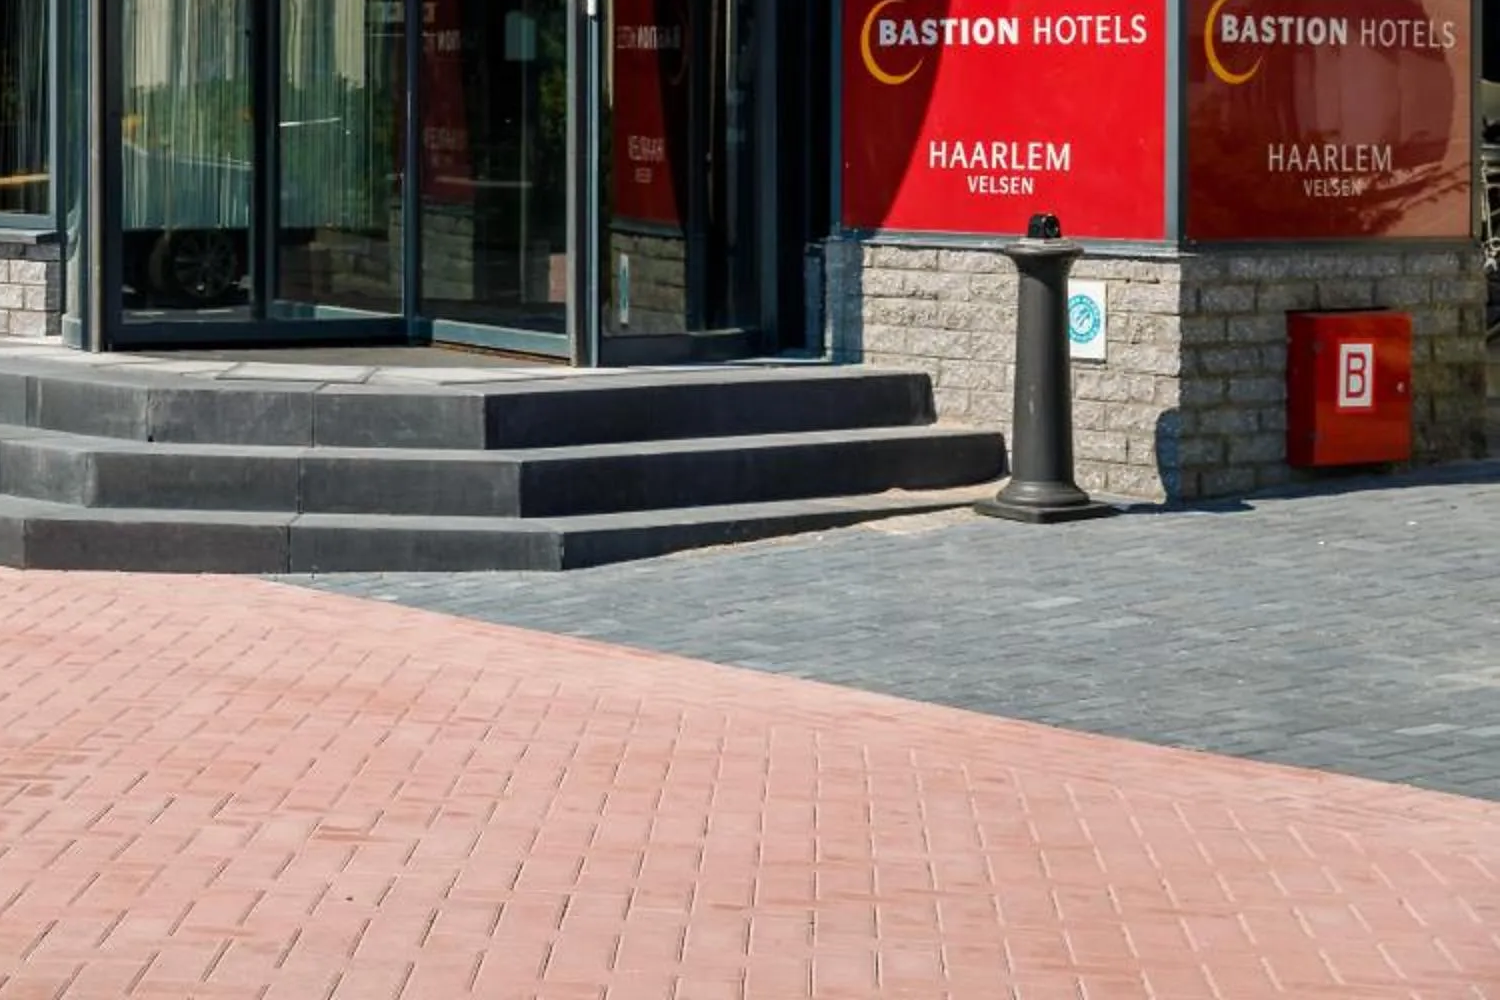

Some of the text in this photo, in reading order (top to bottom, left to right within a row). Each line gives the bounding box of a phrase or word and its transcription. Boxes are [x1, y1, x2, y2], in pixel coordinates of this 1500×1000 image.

[879, 14, 1148, 45] BASTION HOTELS
[1221, 14, 1457, 49] BASTION HOTELS
[929, 140, 1071, 171] HAARLEM
[1268, 143, 1392, 172] HAARLEM
[967, 175, 1034, 195] VELSEN
[1303, 178, 1363, 197] VELSEN
[1346, 352, 1367, 398] B
